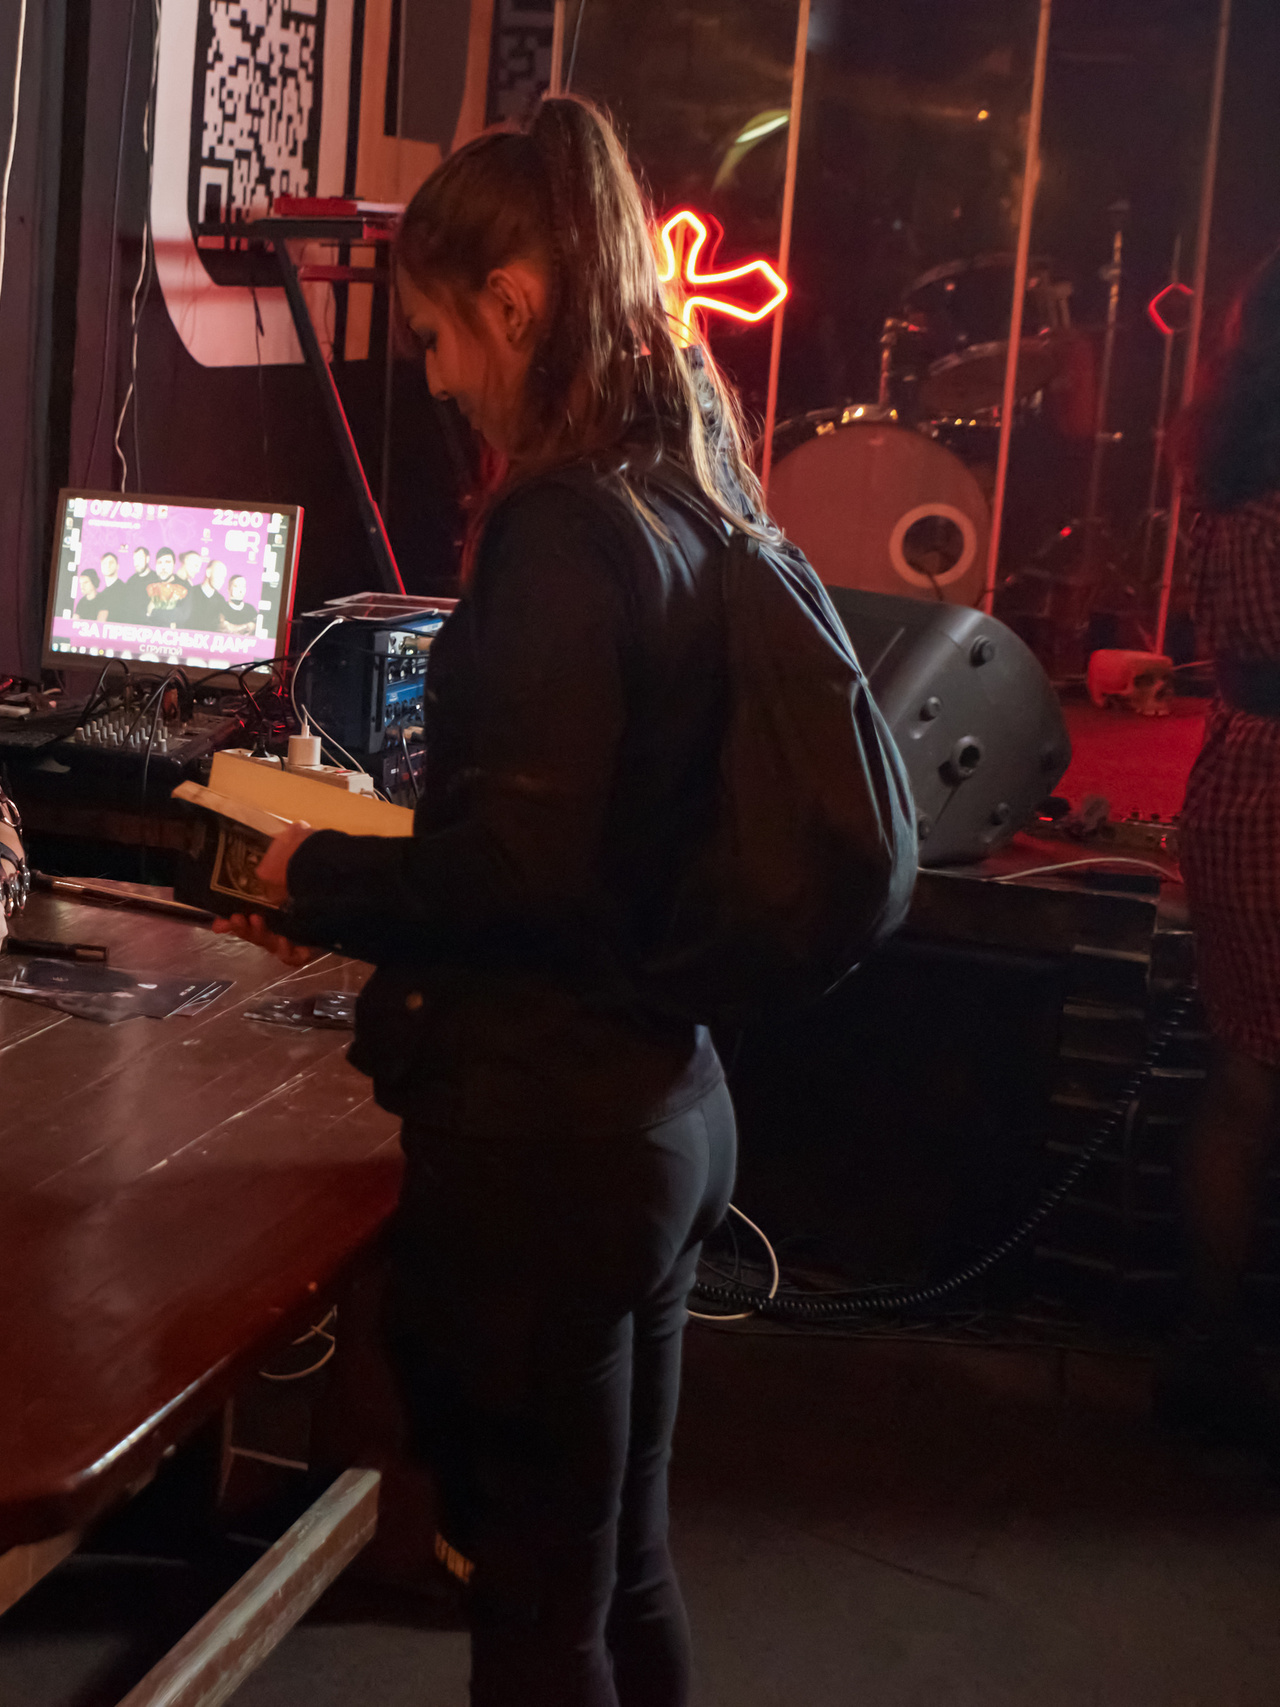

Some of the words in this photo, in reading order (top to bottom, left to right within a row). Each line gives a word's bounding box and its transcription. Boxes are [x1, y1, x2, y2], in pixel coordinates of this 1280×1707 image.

[212, 509, 263, 528] 22:00
[103, 624, 209, 649] ПРЕКРАСНЫХ
[147, 646, 182, 656] ГРУППОЙ
